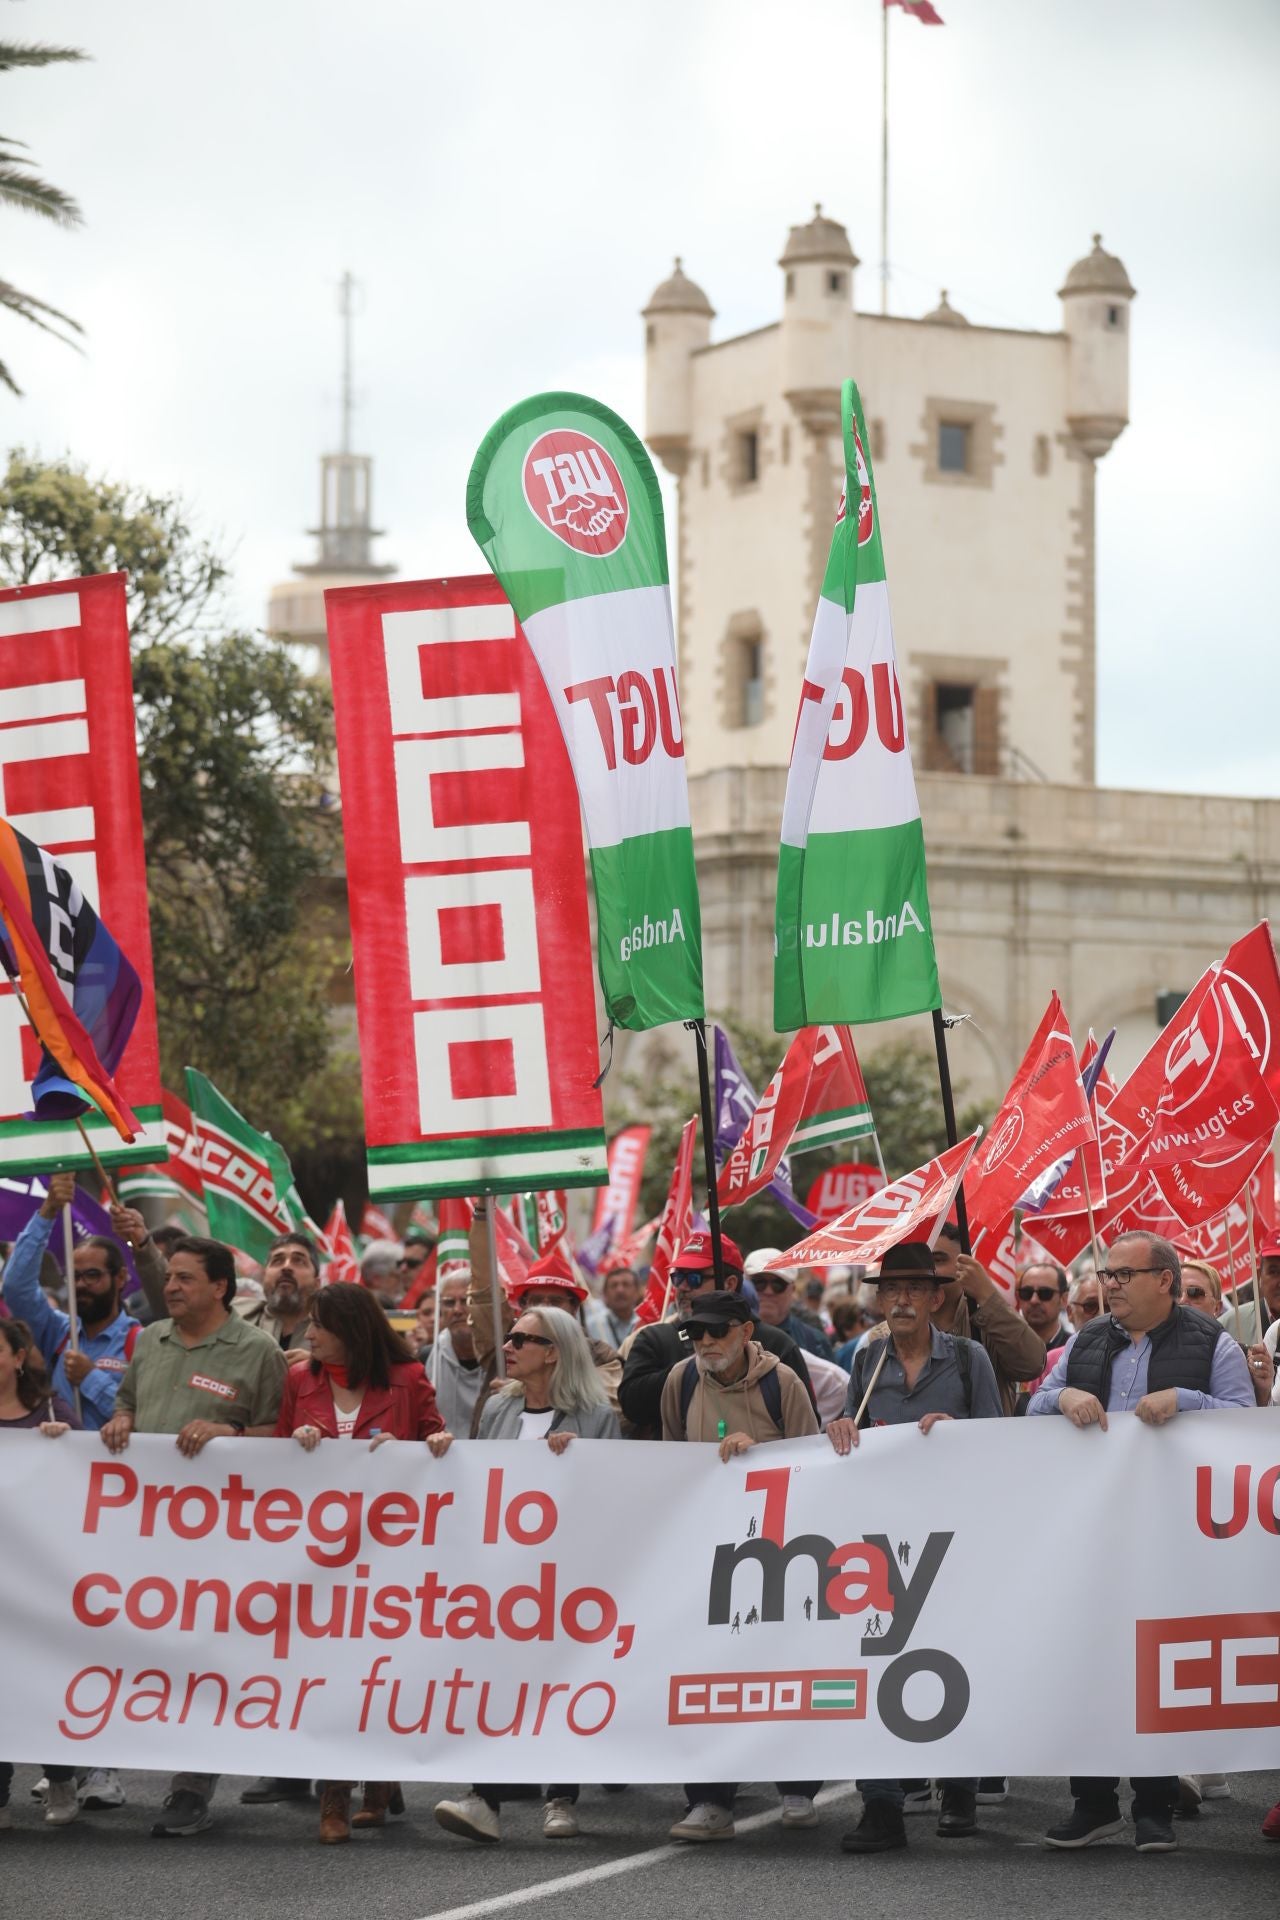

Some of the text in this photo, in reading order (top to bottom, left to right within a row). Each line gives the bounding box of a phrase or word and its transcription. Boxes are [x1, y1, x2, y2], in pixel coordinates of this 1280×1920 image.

[381, 604, 552, 1136] CCOO
[191, 1375, 229, 1396] CCOO
[82, 1461, 559, 1568] Proteger lo
[72, 1563, 636, 1659] conquistado,
[58, 1656, 617, 1741] ganar futuro
[678, 1680, 802, 1715] CCOO
